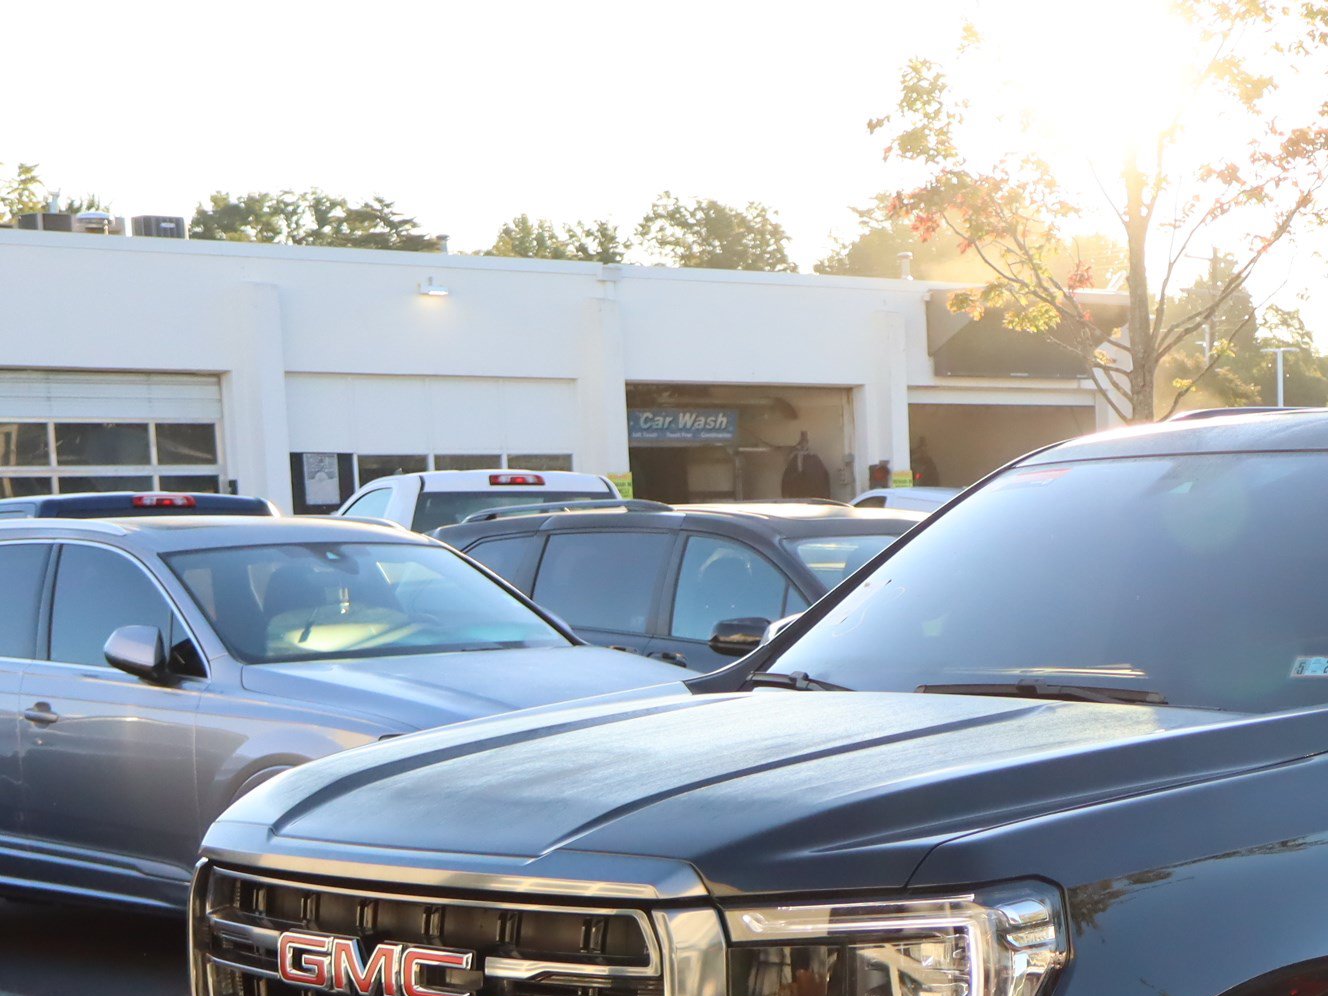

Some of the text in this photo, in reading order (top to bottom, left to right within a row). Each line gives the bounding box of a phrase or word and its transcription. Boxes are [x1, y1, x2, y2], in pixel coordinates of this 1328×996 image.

[640, 412, 728, 430] Car Wash
[1296, 661, 1306, 675] 5
